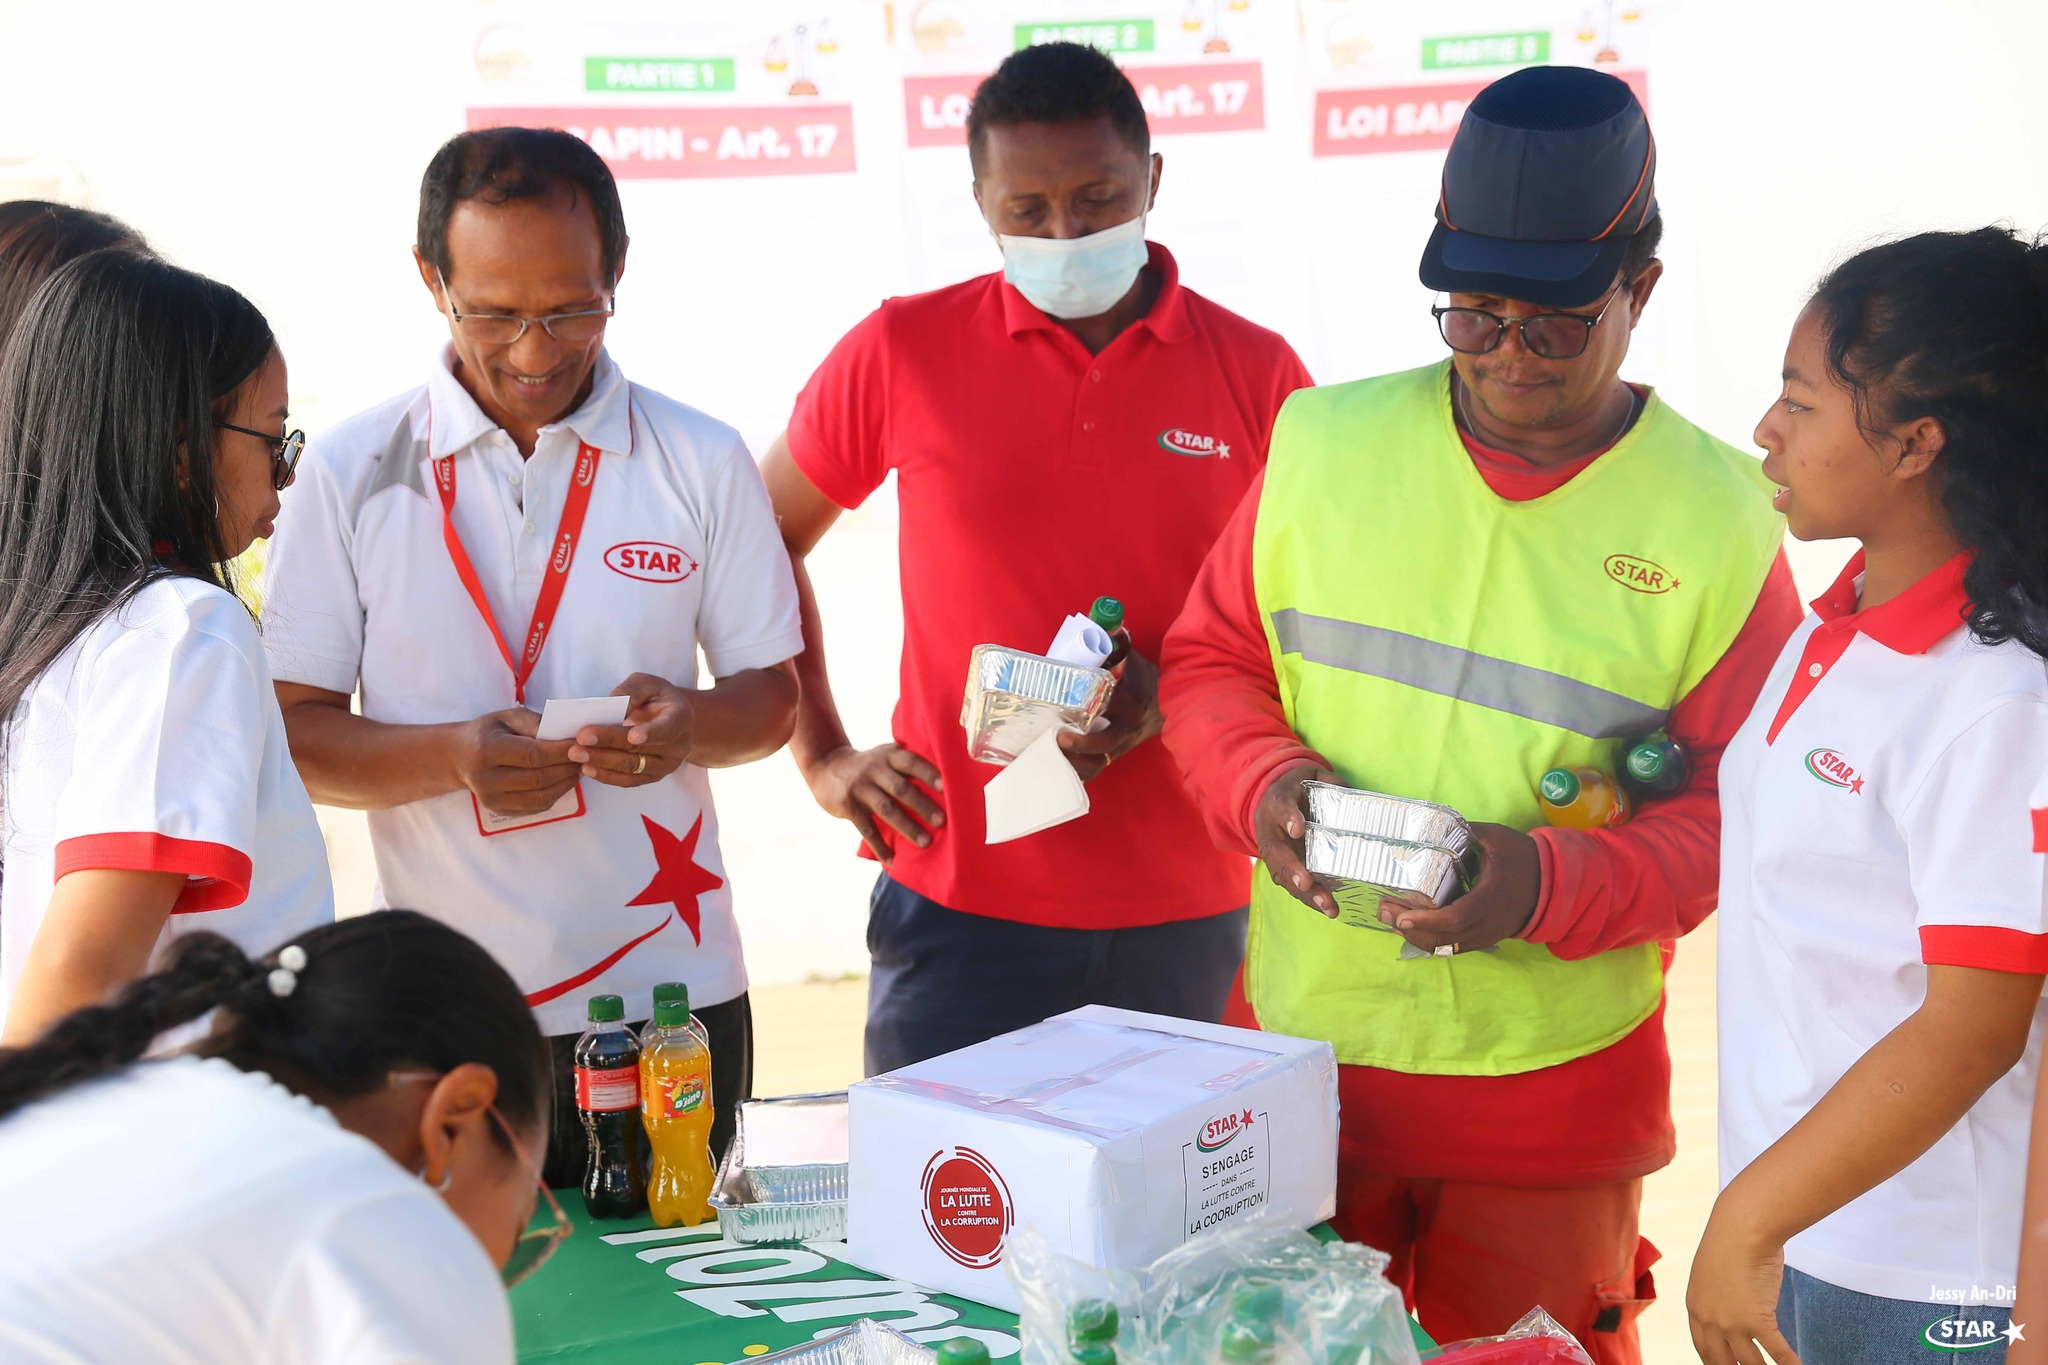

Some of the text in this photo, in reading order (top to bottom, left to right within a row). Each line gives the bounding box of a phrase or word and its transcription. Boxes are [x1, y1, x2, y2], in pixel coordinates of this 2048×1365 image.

[1120, 24, 1139, 49] 2
[1436, 38, 1516, 65] PARTIE
[606, 62, 715, 90] PARTIE 1
[920, 80, 1250, 129] LO Art. 17
[1327, 100, 1471, 140] LOI SAP
[716, 124, 793, 161] Art.
[795, 123, 839, 159] 17
[1174, 430, 1214, 450] STAR
[576, 457, 591, 480] STAR
[554, 541, 567, 565] STAR
[620, 549, 681, 574] STAR
[1613, 560, 1664, 589] STAR
[528, 631, 540, 655] STAR
[1819, 752, 1854, 782] STAR
[1207, 1113, 1238, 1139] STAR
[1202, 1146, 1254, 1178] S'ENGAGE
[1221, 1174, 1238, 1187] DANS
[941, 1194, 991, 1207] LA LUTTE
[1201, 1179, 1256, 1210] LA LUTTE CONTRE
[940, 1217, 999, 1226] LA CORRUPTION
[1190, 1191, 1264, 1235] LA COORUPTION
